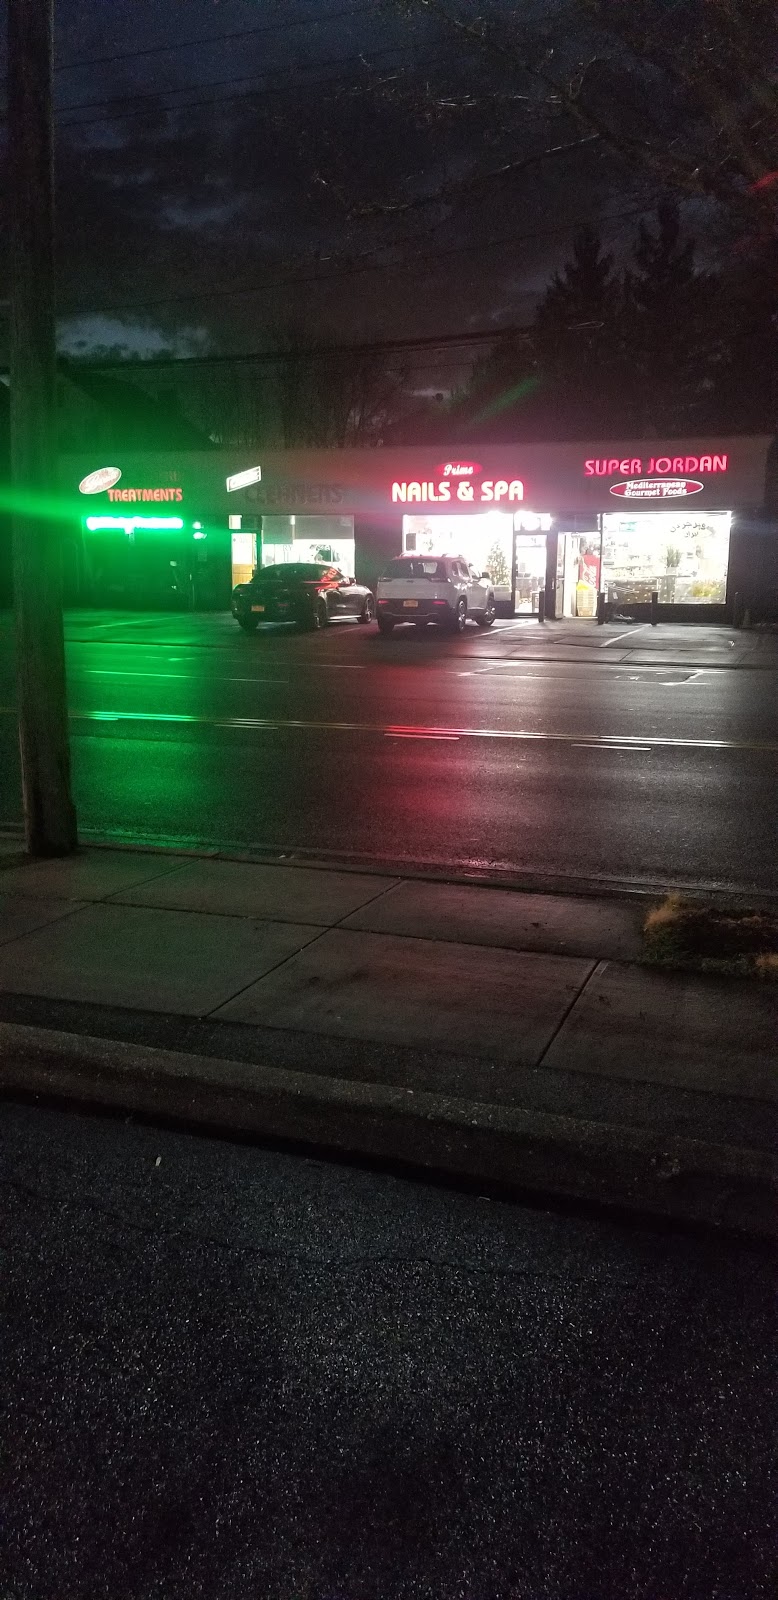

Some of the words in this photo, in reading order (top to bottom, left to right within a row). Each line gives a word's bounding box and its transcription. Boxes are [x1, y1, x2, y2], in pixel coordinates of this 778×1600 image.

[443, 464, 474, 477] Prime
[585, 458, 642, 475] SUPER
[647, 455, 728, 474] JORDAN
[391, 481, 451, 503] NAILS
[457, 481, 475, 501] &
[480, 480, 524, 502] SPA
[626, 481, 687, 490] Mediterranean
[107, 488, 183, 502] TREATMENTS
[624, 488, 661, 497] Gourmet
[662, 488, 688, 497] Foods
